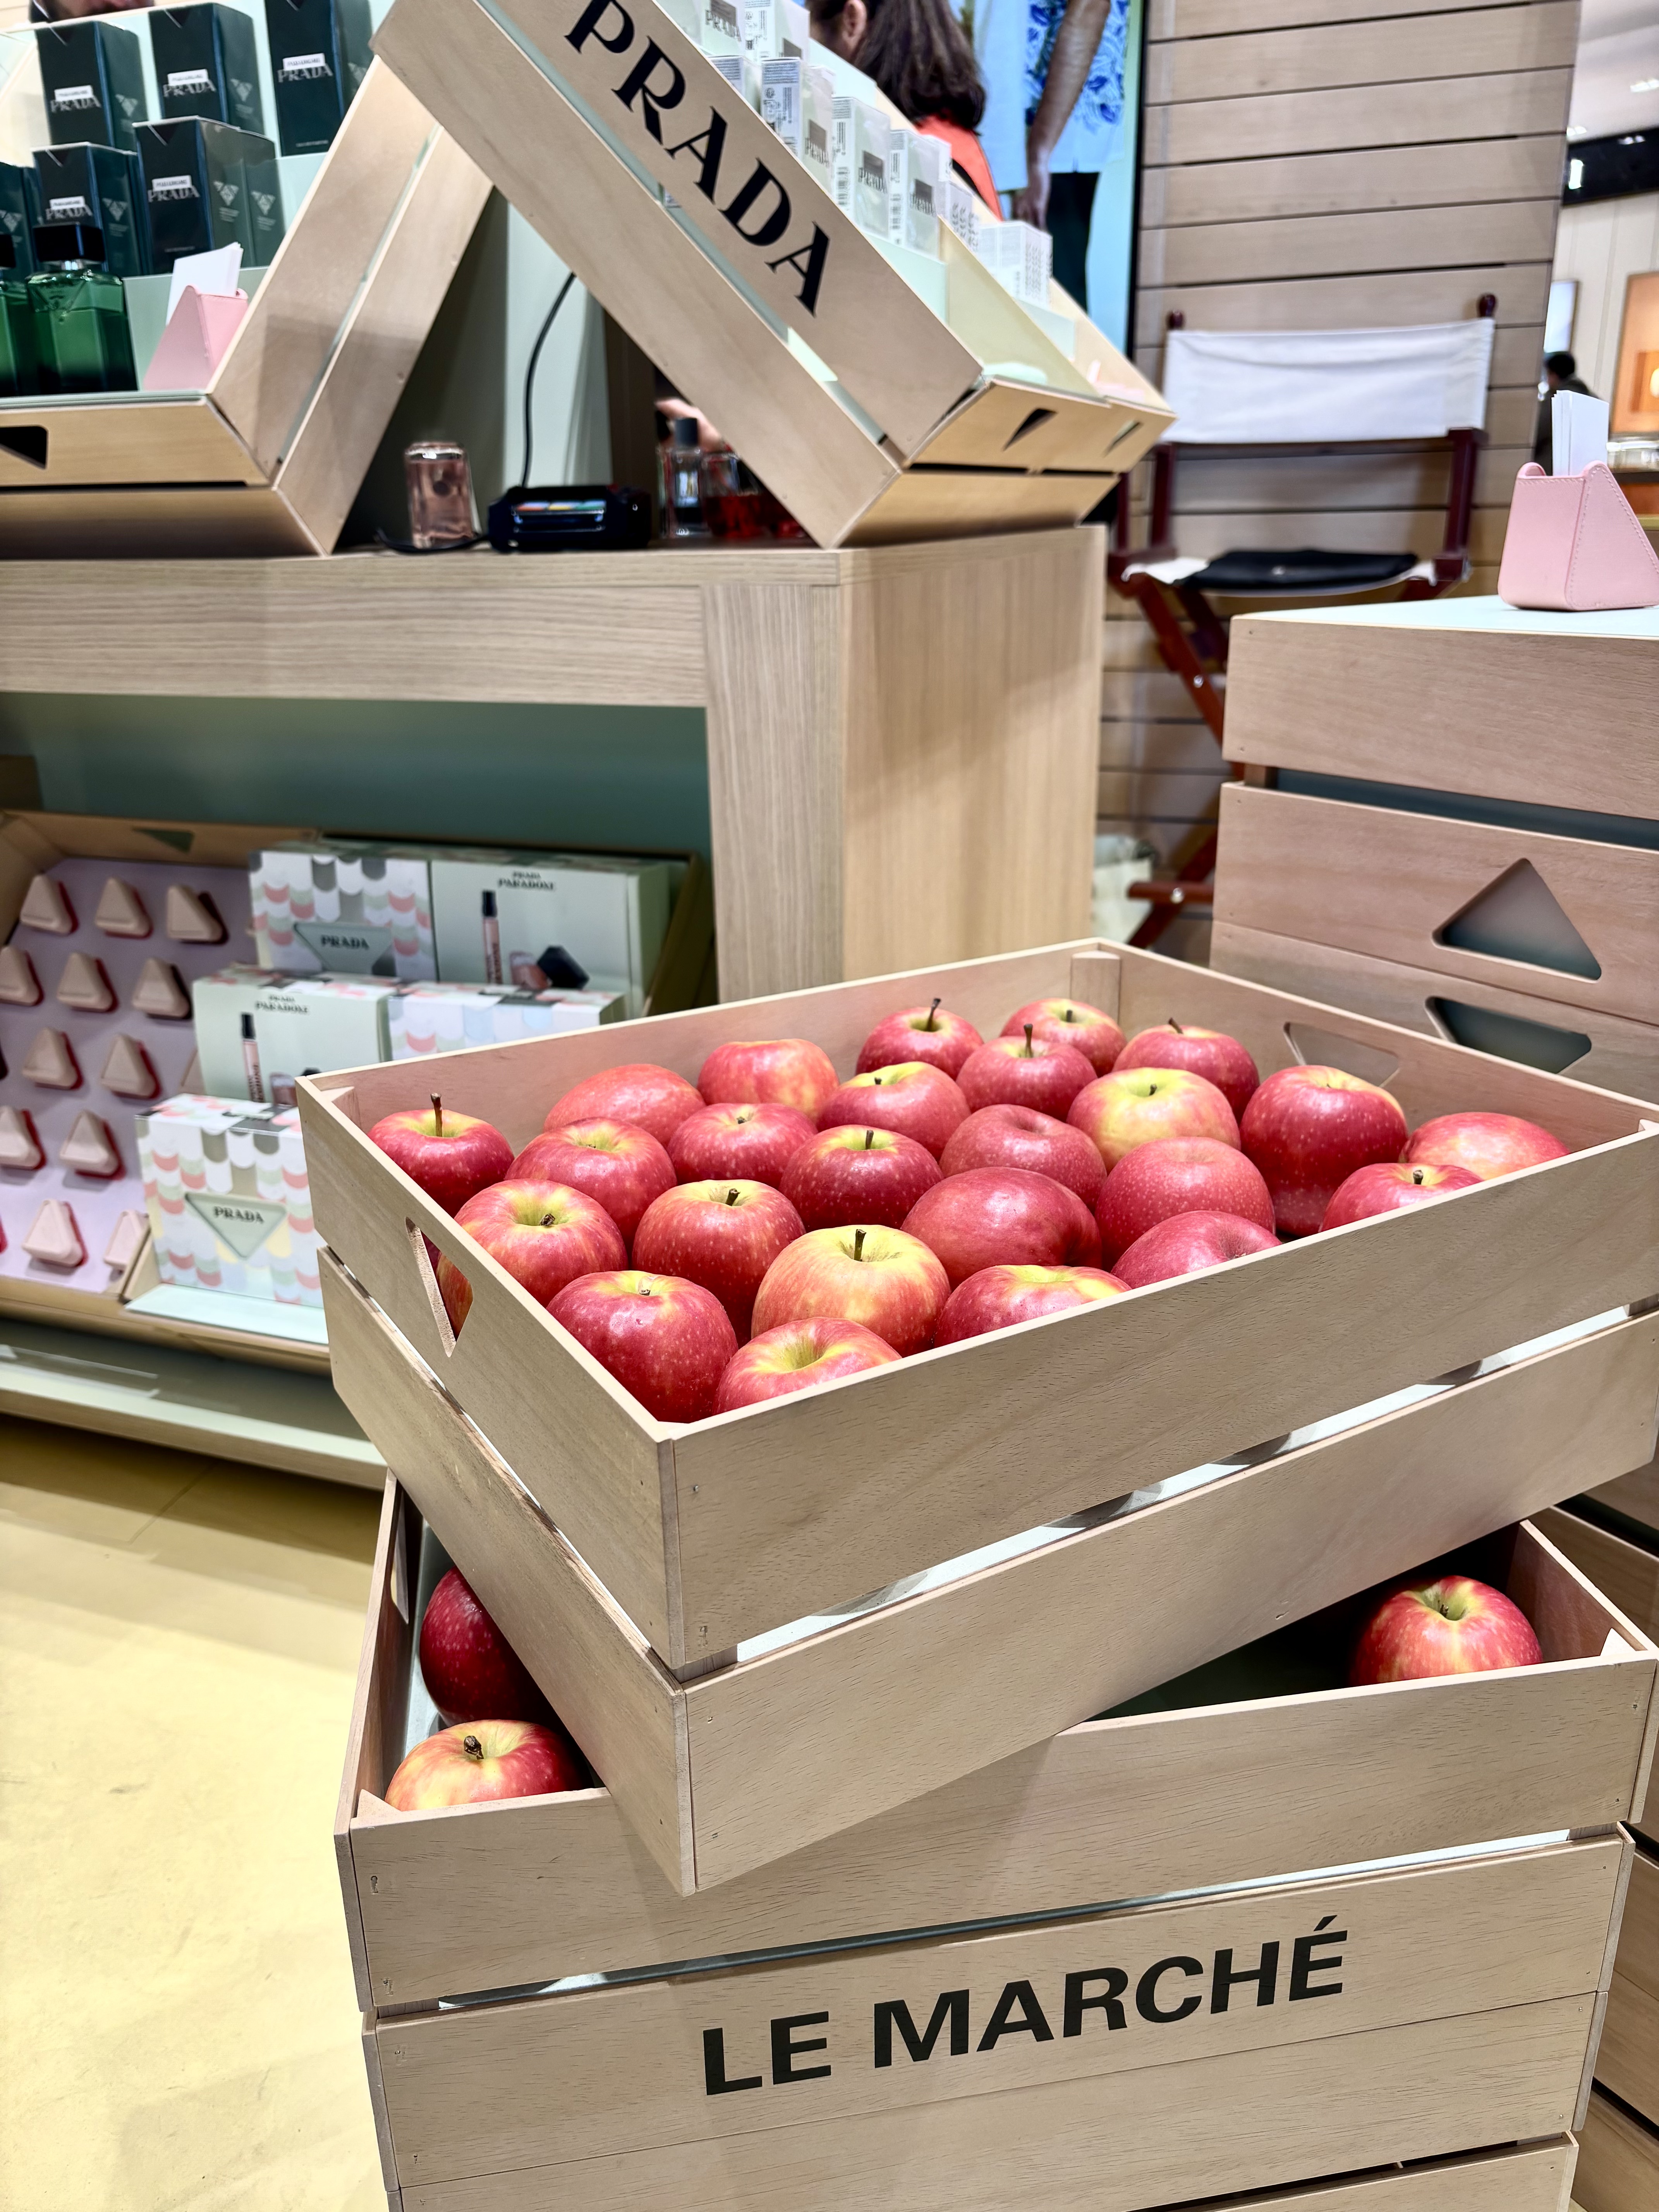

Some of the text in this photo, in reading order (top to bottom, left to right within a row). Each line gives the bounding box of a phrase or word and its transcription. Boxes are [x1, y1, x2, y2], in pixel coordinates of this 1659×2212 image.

[277, 64, 333, 83] PRADA
[163, 80, 216, 97] PRADA
[50, 95, 102, 113] PRADA
[564, 0, 830, 318] PRADA
[147, 185, 200, 203] PRADA
[45, 204, 93, 220] PRADA
[321, 934, 369, 950] PRADA
[214, 1206, 264, 1224] PRADA
[703, 1915, 1348, 2095] LE MARCHÉ
